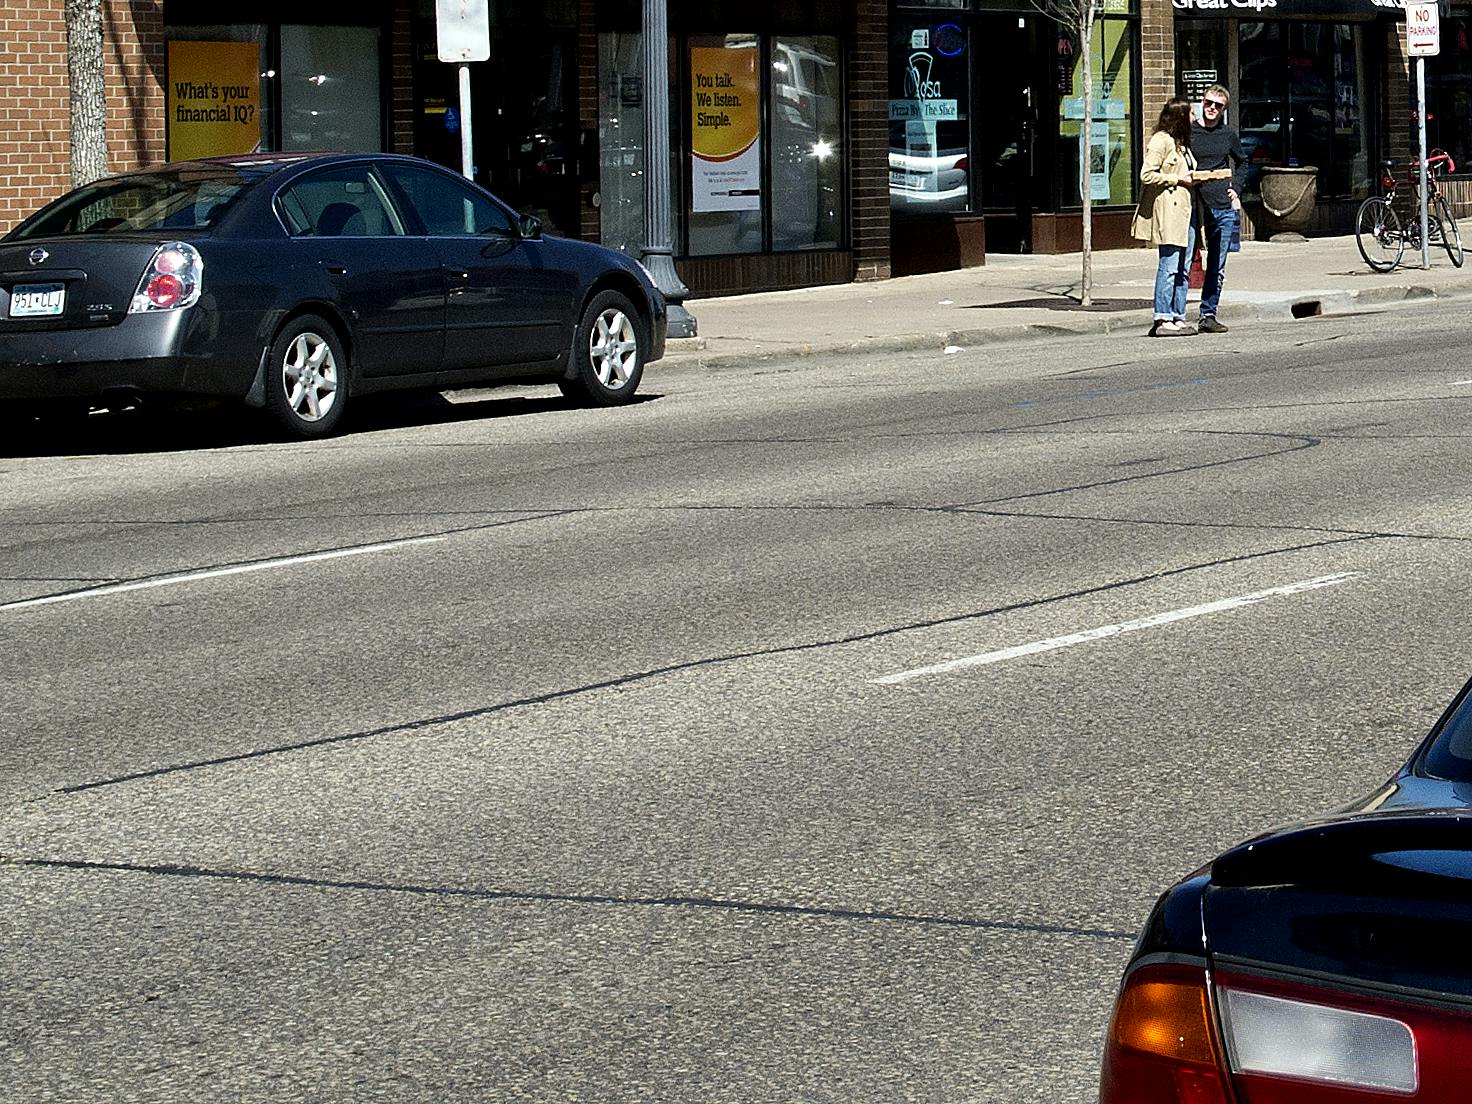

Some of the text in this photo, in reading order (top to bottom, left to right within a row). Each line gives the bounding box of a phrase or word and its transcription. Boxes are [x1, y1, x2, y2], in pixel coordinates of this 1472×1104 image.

[1416, 10, 1429, 22] NO
[1409, 27, 1436, 36] PARKING
[696, 73, 735, 87] You talk.
[175, 82, 250, 102] What's your
[697, 92, 742, 107] We listen.
[176, 104, 255, 124] financial IQ?
[925, 104, 937, 116] The
[938, 104, 955, 116] Slice
[697, 112, 732, 129] Simple.
